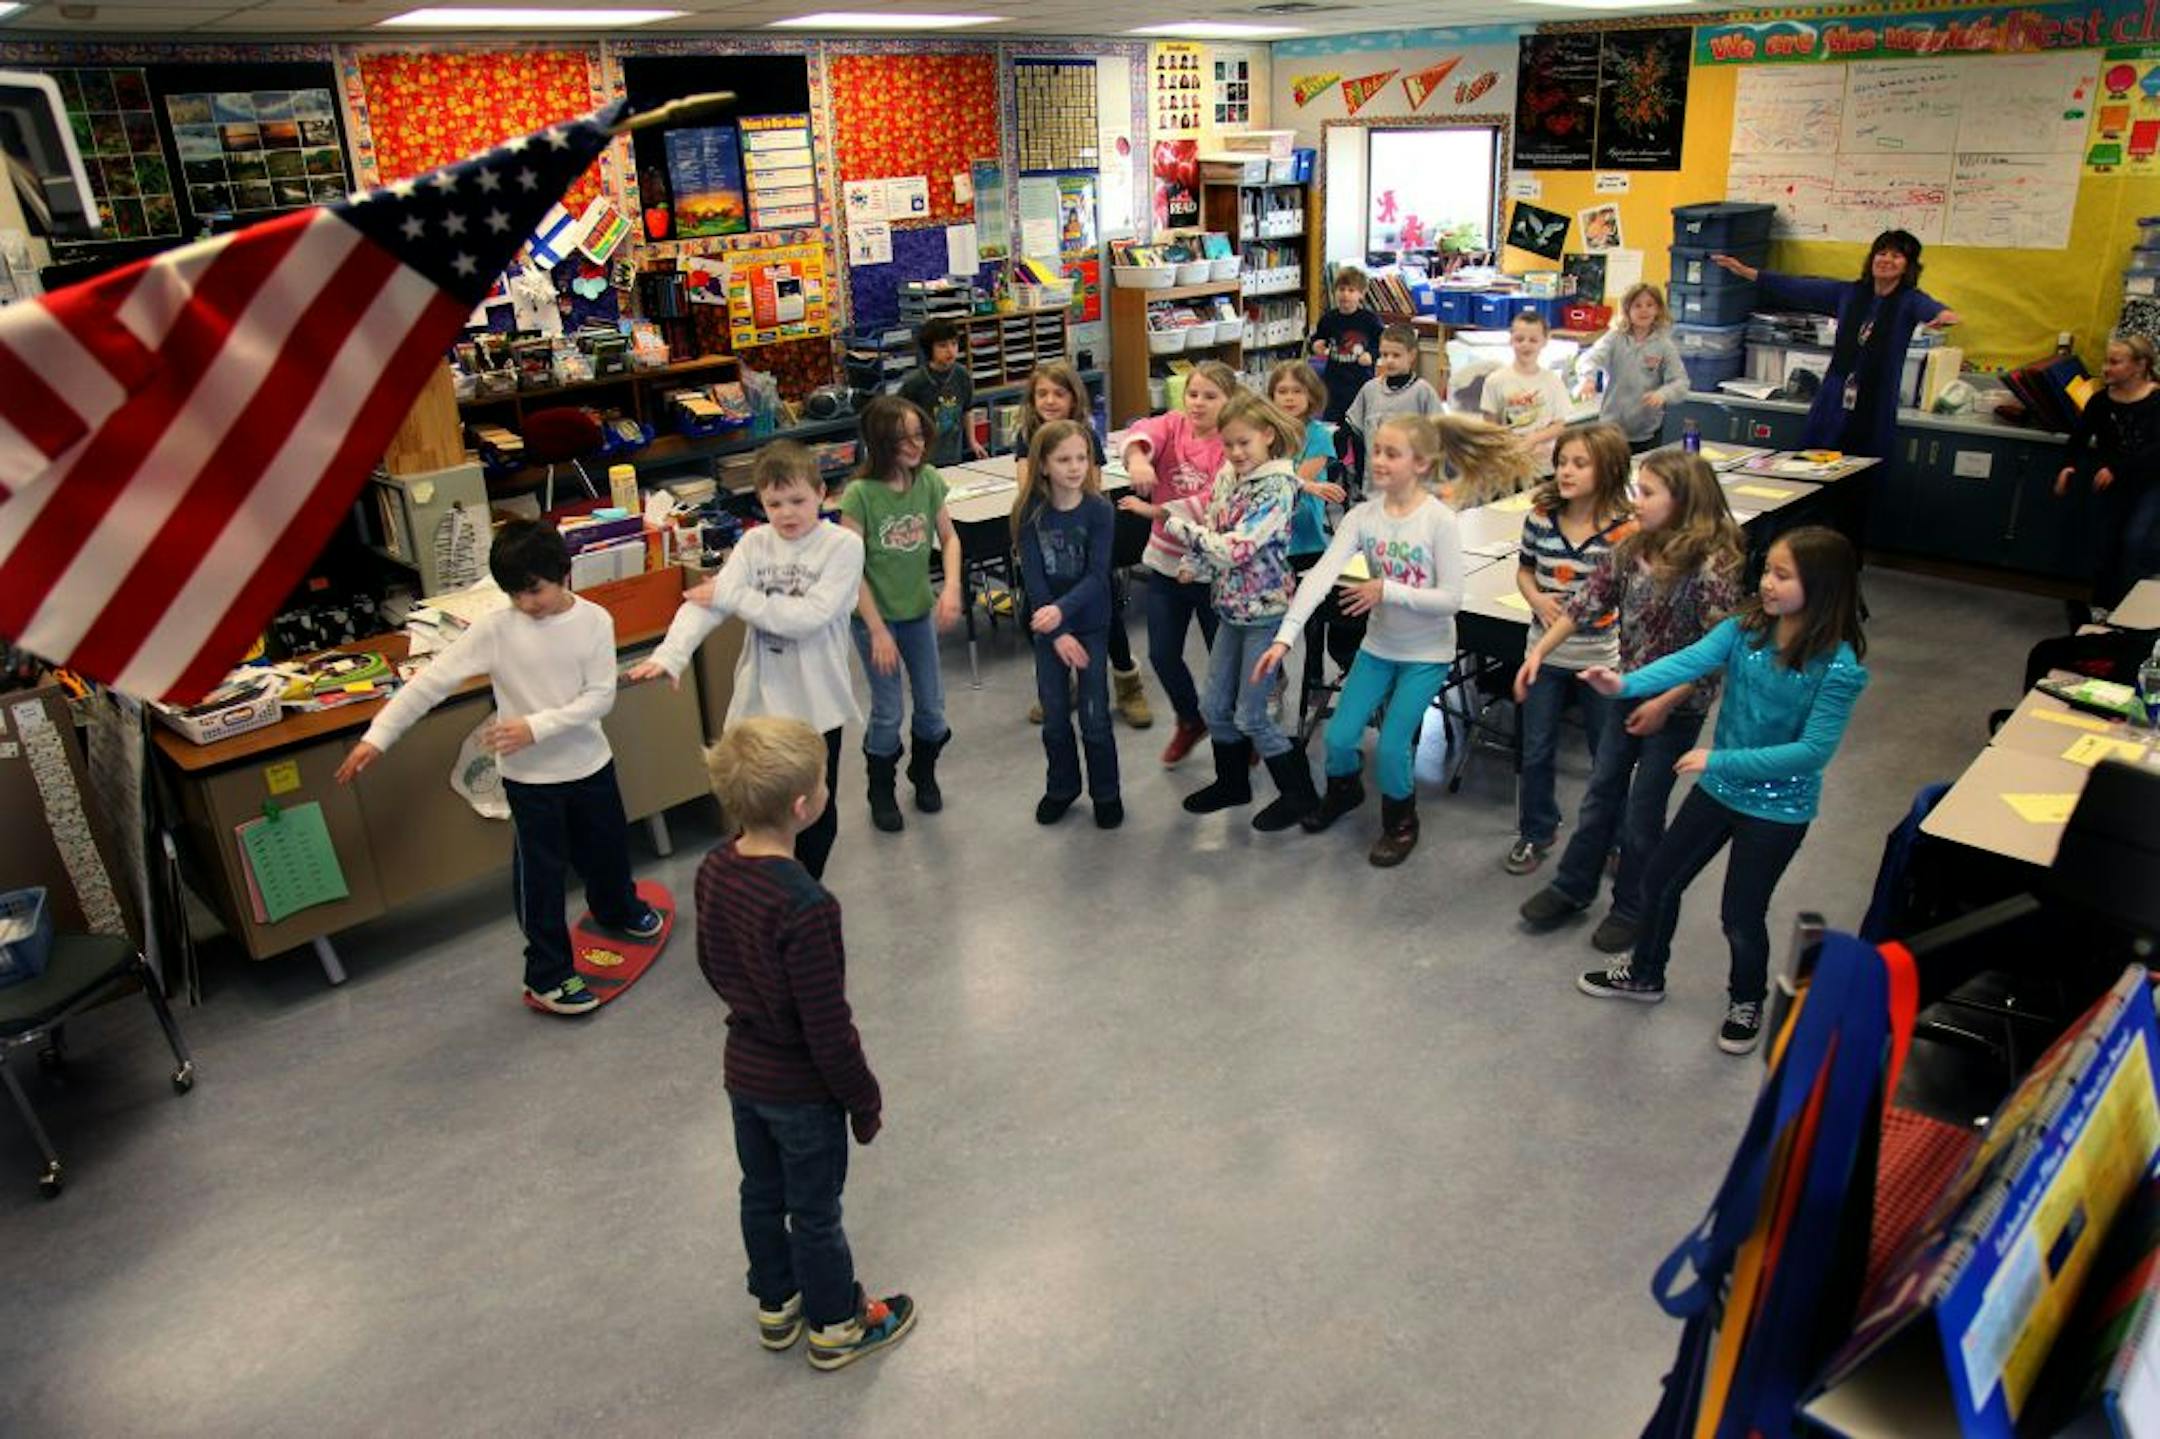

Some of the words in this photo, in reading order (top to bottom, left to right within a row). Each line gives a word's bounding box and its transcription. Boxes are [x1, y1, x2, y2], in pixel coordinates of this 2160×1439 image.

[1710, 33, 1756, 60] We
[1765, 31, 1816, 54] are
[1823, 25, 1876, 51] the
[1169, 201, 1197, 215] READ
